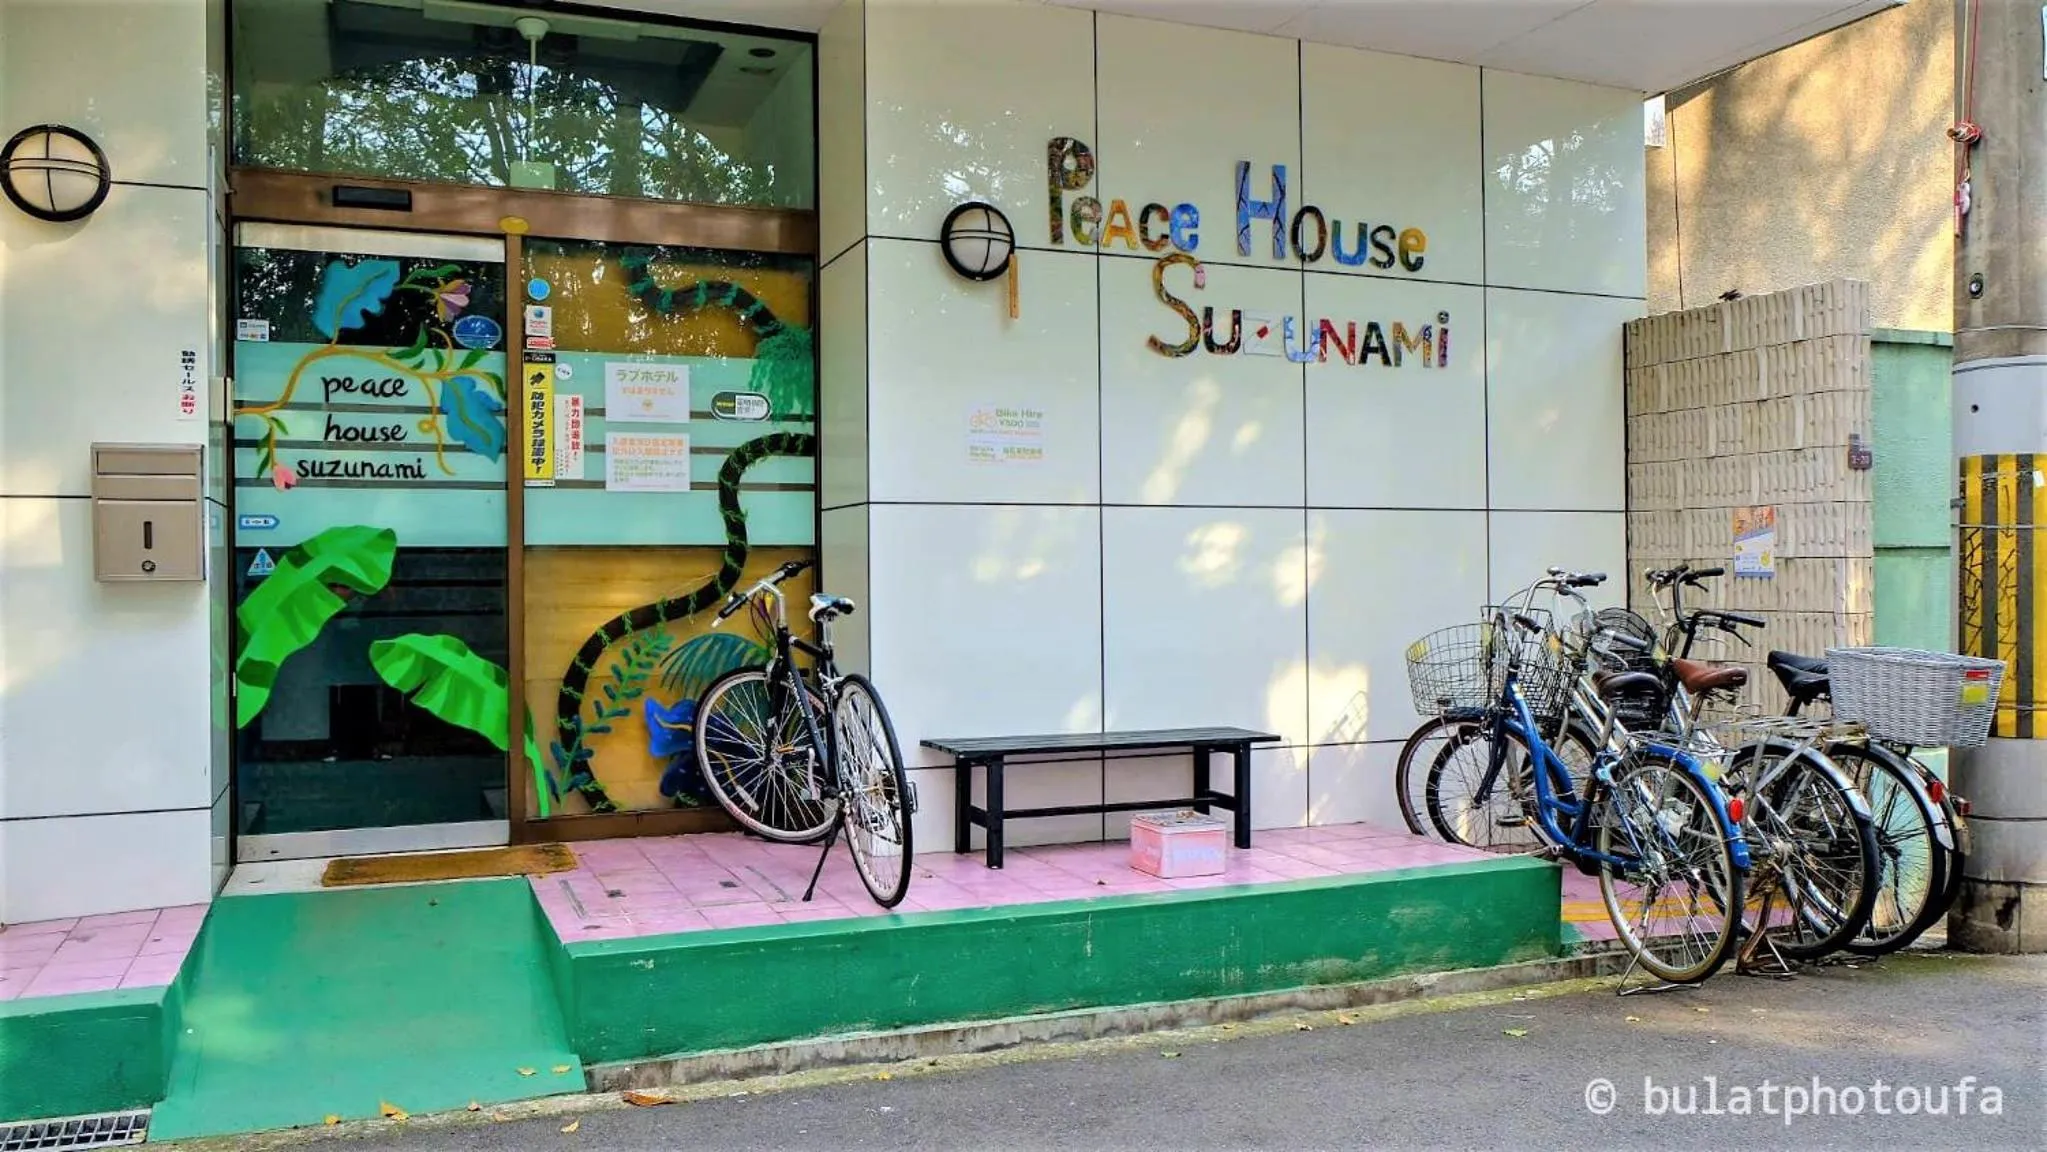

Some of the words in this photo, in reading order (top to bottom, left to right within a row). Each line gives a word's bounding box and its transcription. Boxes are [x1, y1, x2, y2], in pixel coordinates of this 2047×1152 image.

[615, 368, 679, 383] ラブホテル
[321, 377, 408, 403] peace
[324, 413, 407, 441] house
[296, 458, 426, 479] suzunami
